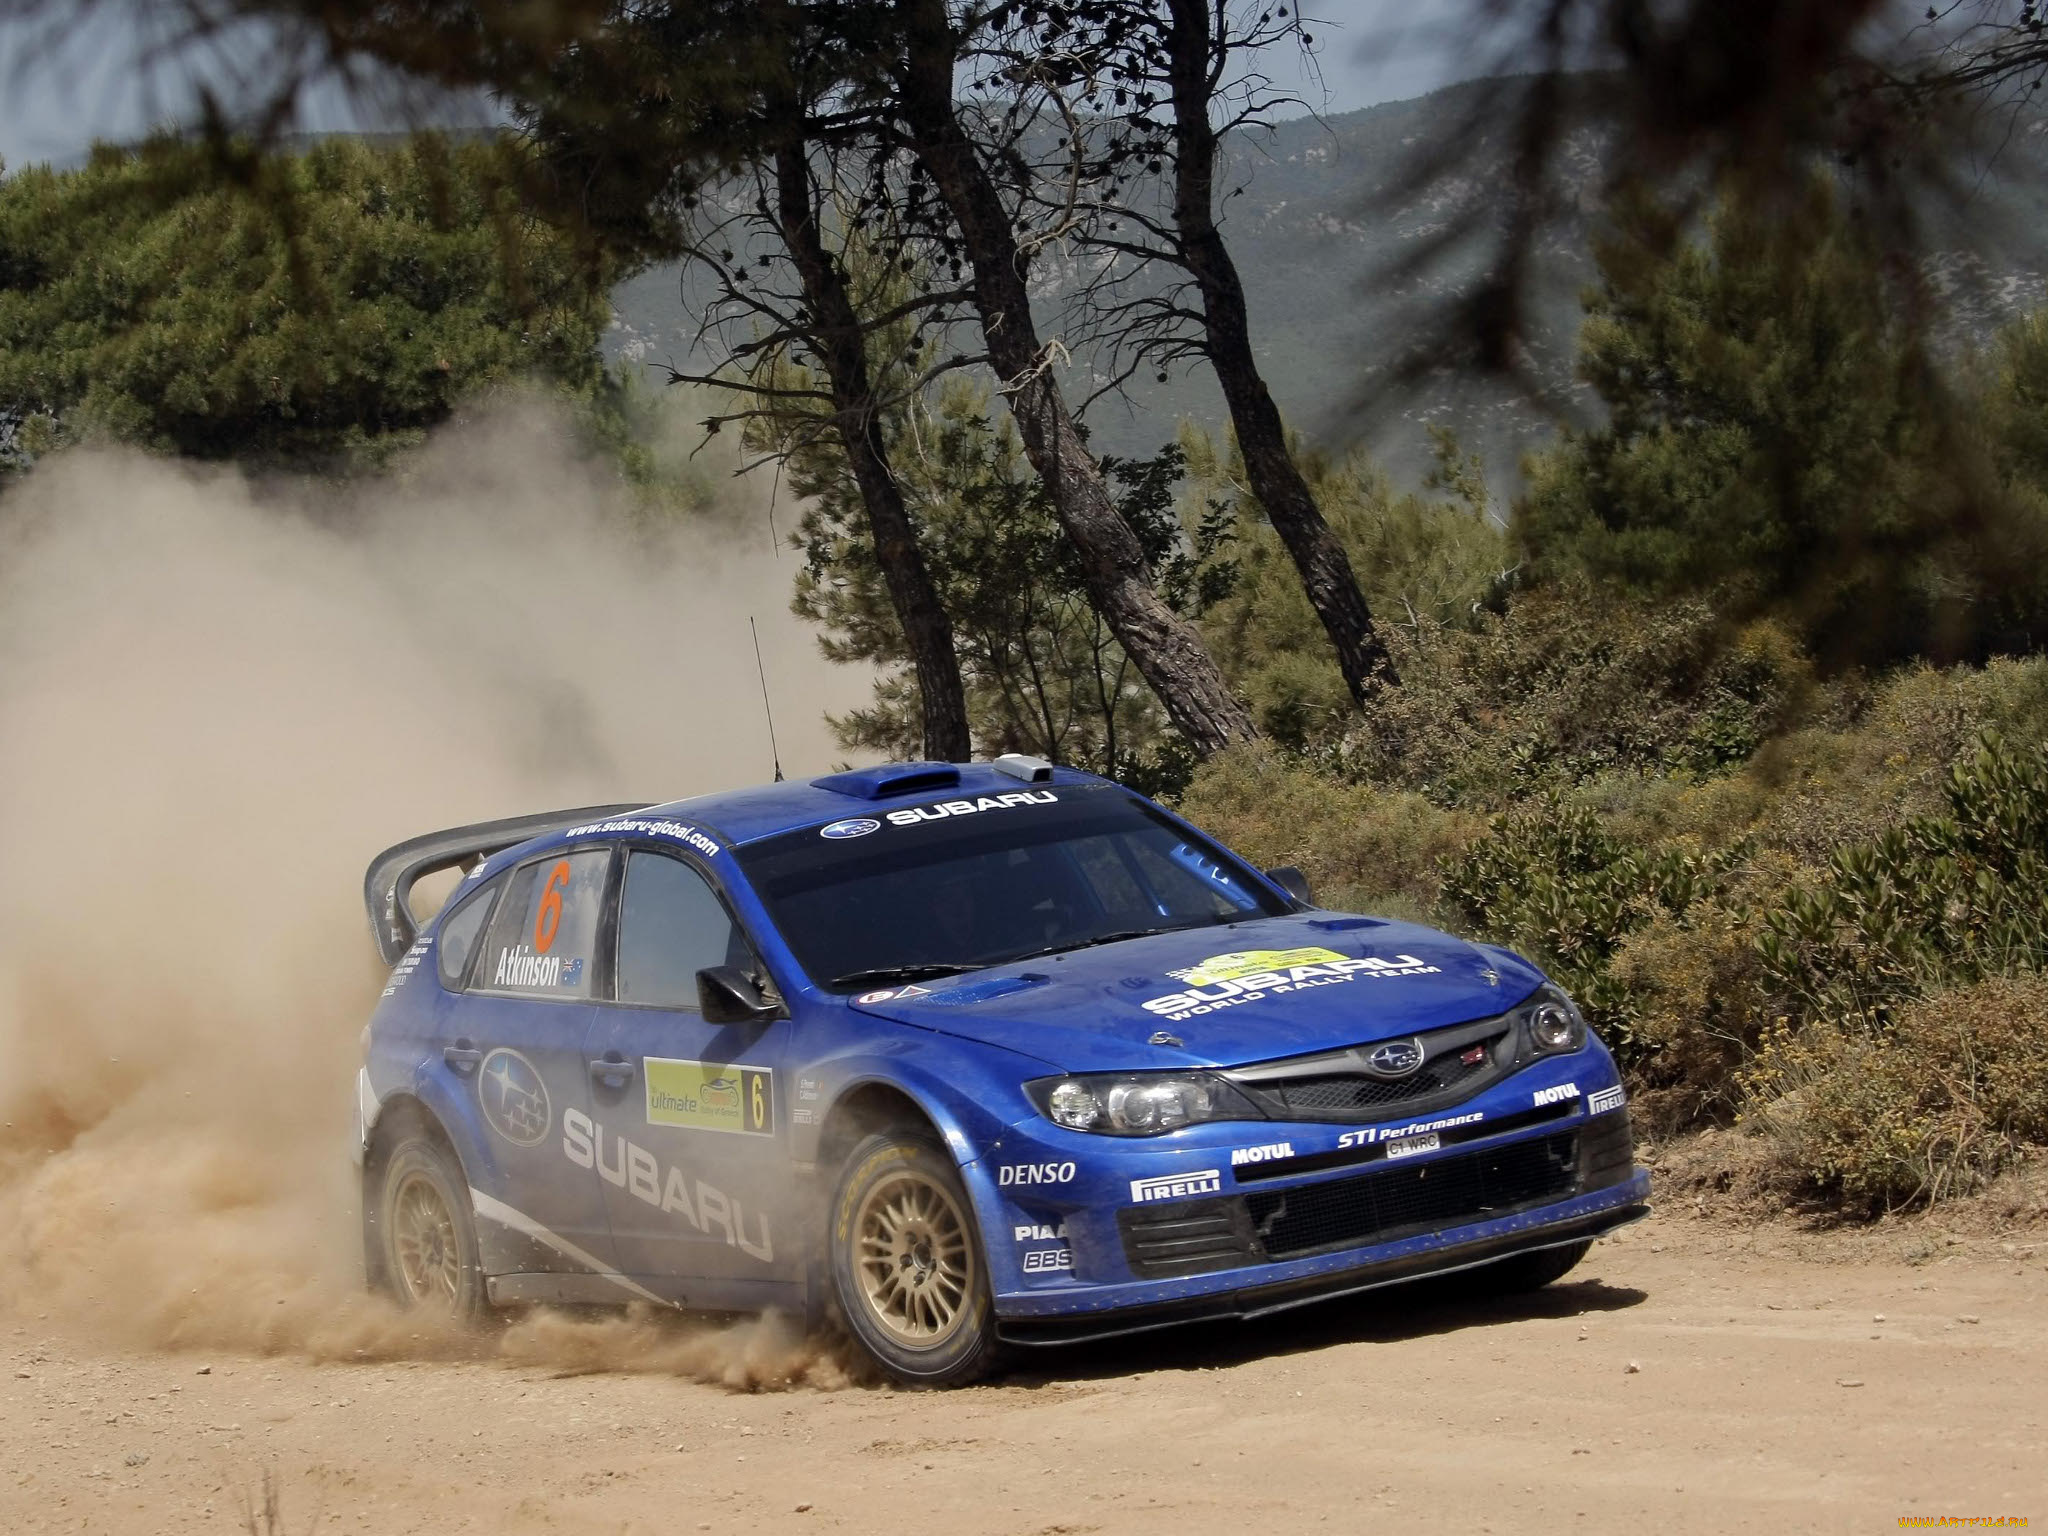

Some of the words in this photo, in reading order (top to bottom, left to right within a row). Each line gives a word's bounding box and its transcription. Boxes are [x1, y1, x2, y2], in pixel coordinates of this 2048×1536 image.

[886, 790, 1058, 826] SUBARU
[566, 819, 720, 857] www.subaru-global.com
[535, 860, 570, 954] 6
[494, 945, 560, 986] Atkinson
[1141, 954, 1425, 1014] SUBARU
[1165, 990, 1266, 1022] WORLD
[1272, 973, 1355, 994] RALLY
[1364, 965, 1442, 980] TEAM
[650, 1091, 698, 1113] ultimate
[752, 1074, 765, 1129] 6
[1534, 1083, 1580, 1107] MOTUL
[1337, 1128, 1375, 1149] STI
[1379, 1112, 1484, 1142] Performance
[1408, 1135, 1437, 1151] WRC
[1231, 1143, 1295, 1165] MOTUL
[563, 1107, 774, 1263] SUBARU
[999, 1162, 1076, 1186] DENSO
[1130, 1169, 1221, 1203] PIRELLI
[1023, 1249, 1074, 1272] BBS
